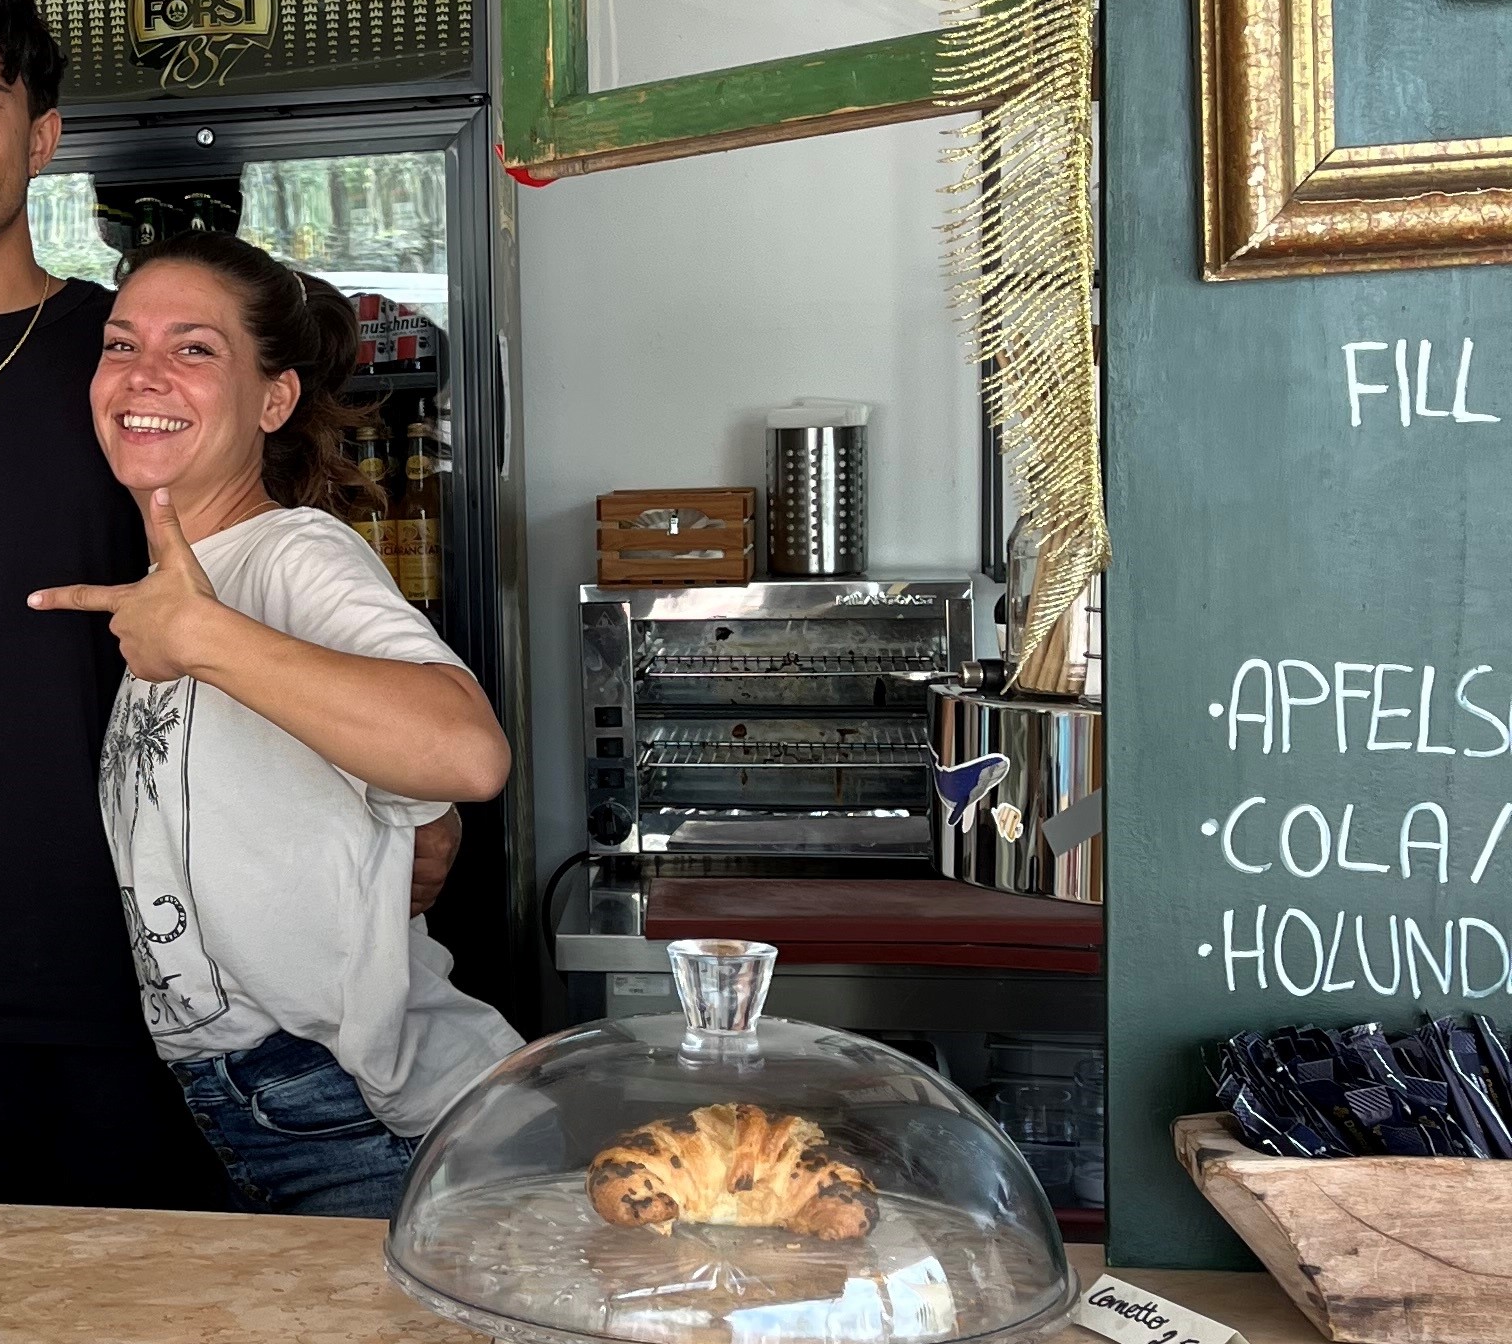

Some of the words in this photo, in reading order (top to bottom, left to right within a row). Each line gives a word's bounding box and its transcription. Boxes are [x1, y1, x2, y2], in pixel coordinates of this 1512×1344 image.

[159, 33, 254, 90] 1857
[1341, 337, 1501, 427] FILL
[1227, 658, 1512, 757] APFELS
[1223, 903, 1512, 999] HOLUND
